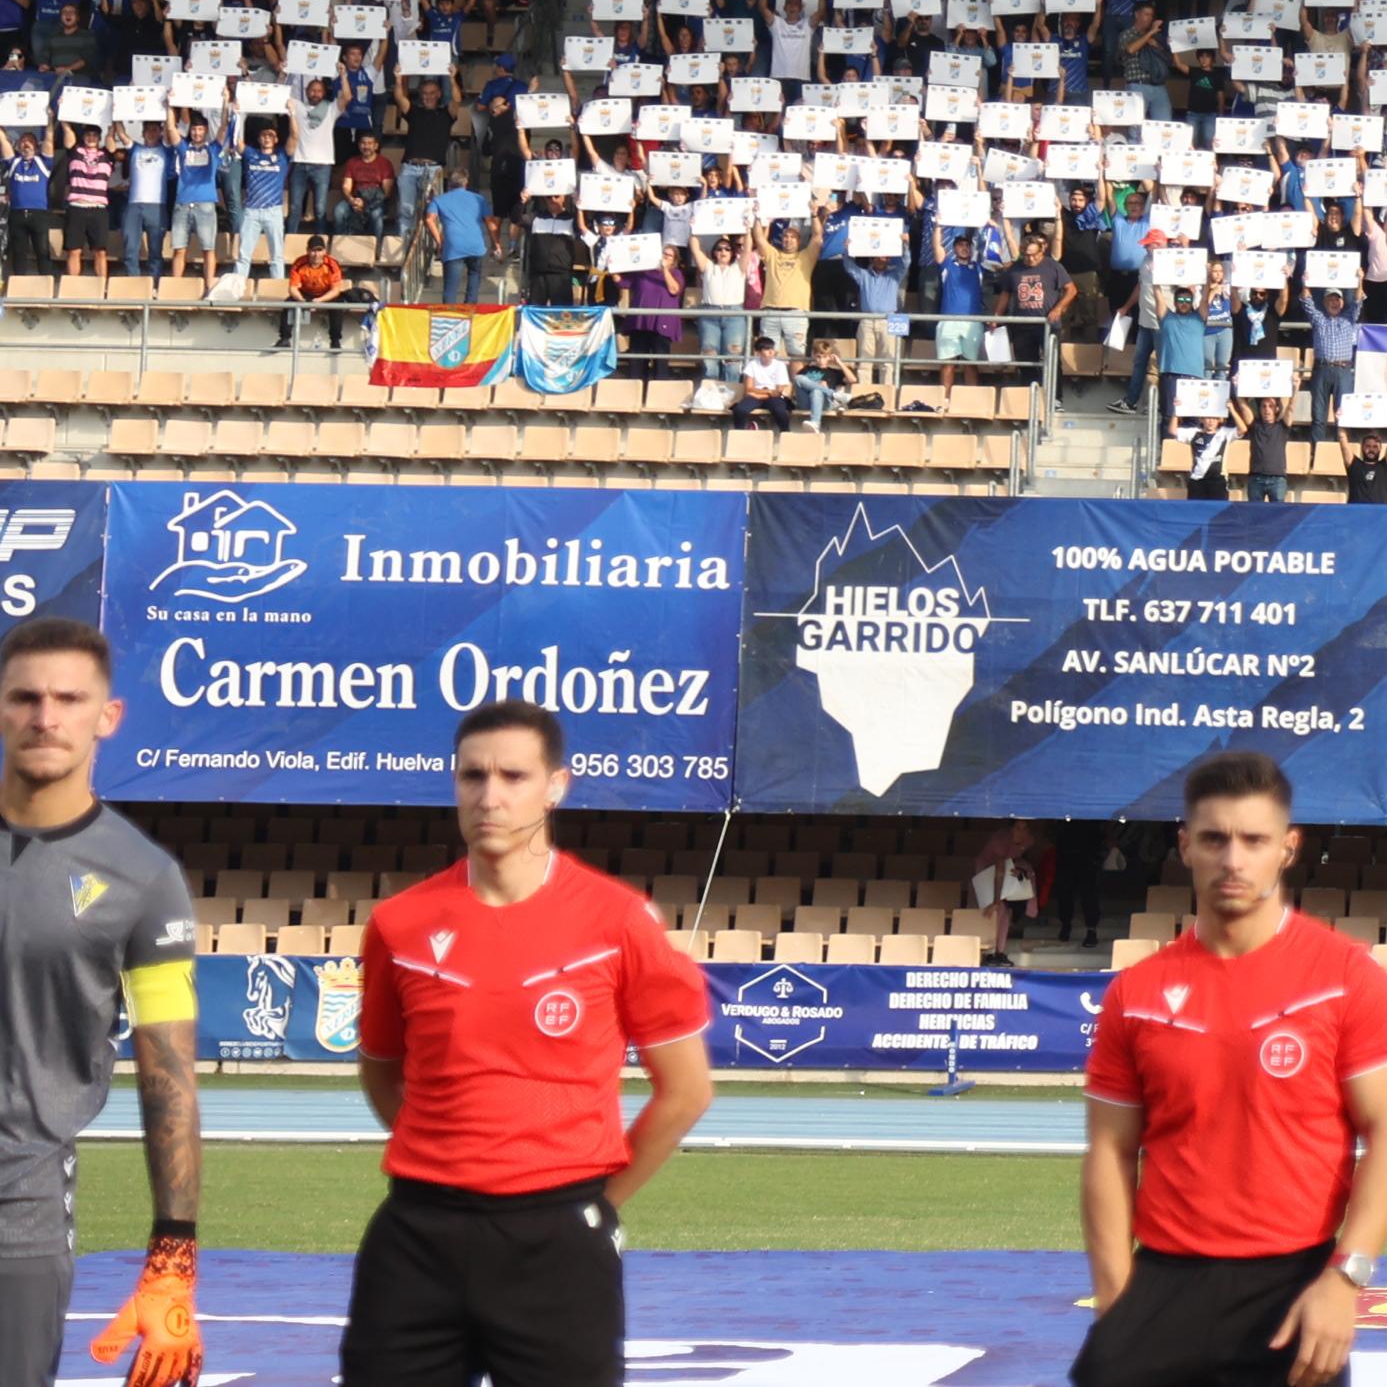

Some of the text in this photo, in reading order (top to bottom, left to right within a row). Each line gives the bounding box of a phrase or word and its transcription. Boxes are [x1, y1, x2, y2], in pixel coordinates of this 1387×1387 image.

[888, 323, 907, 332] 229
[340, 534, 730, 591] Inmobiliaria
[1051, 546, 1335, 574] 100% AGUA POTABLE
[825, 585, 959, 617] HIELOS
[147, 605, 312, 624] Su casa en la mano
[1083, 597, 1296, 625] TLF. 637 711 401
[801, 619, 976, 653] GARRIDO
[1062, 650, 1107, 674] AV.
[1114, 649, 1259, 676] SANLÚCAR
[160, 637, 711, 716] Carmen Ordoñez
[1010, 699, 1364, 734] Polígono Ind. Asta Regla, 2
[136, 748, 448, 773] C/ Fernando Viola, Edif. Huelva
[571, 754, 729, 780] 956 303 785
[906, 972, 1012, 989] DERECHO PENAL
[546, 1002, 570, 1015] RF
[889, 992, 1028, 1010] DERECHO DE FAMILIA
[545, 1015, 569, 1026] EF
[721, 1004, 844, 1019] VERDUGO & ROSADO
[761, 1017, 801, 1026] ABOGADOS
[769, 1043, 786, 1051] 2012
[872, 1033, 1039, 1050] ACCIDENTE DE TRÁFICO
[1271, 1042, 1295, 1054] RF
[1269, 1056, 1294, 1067] EF
